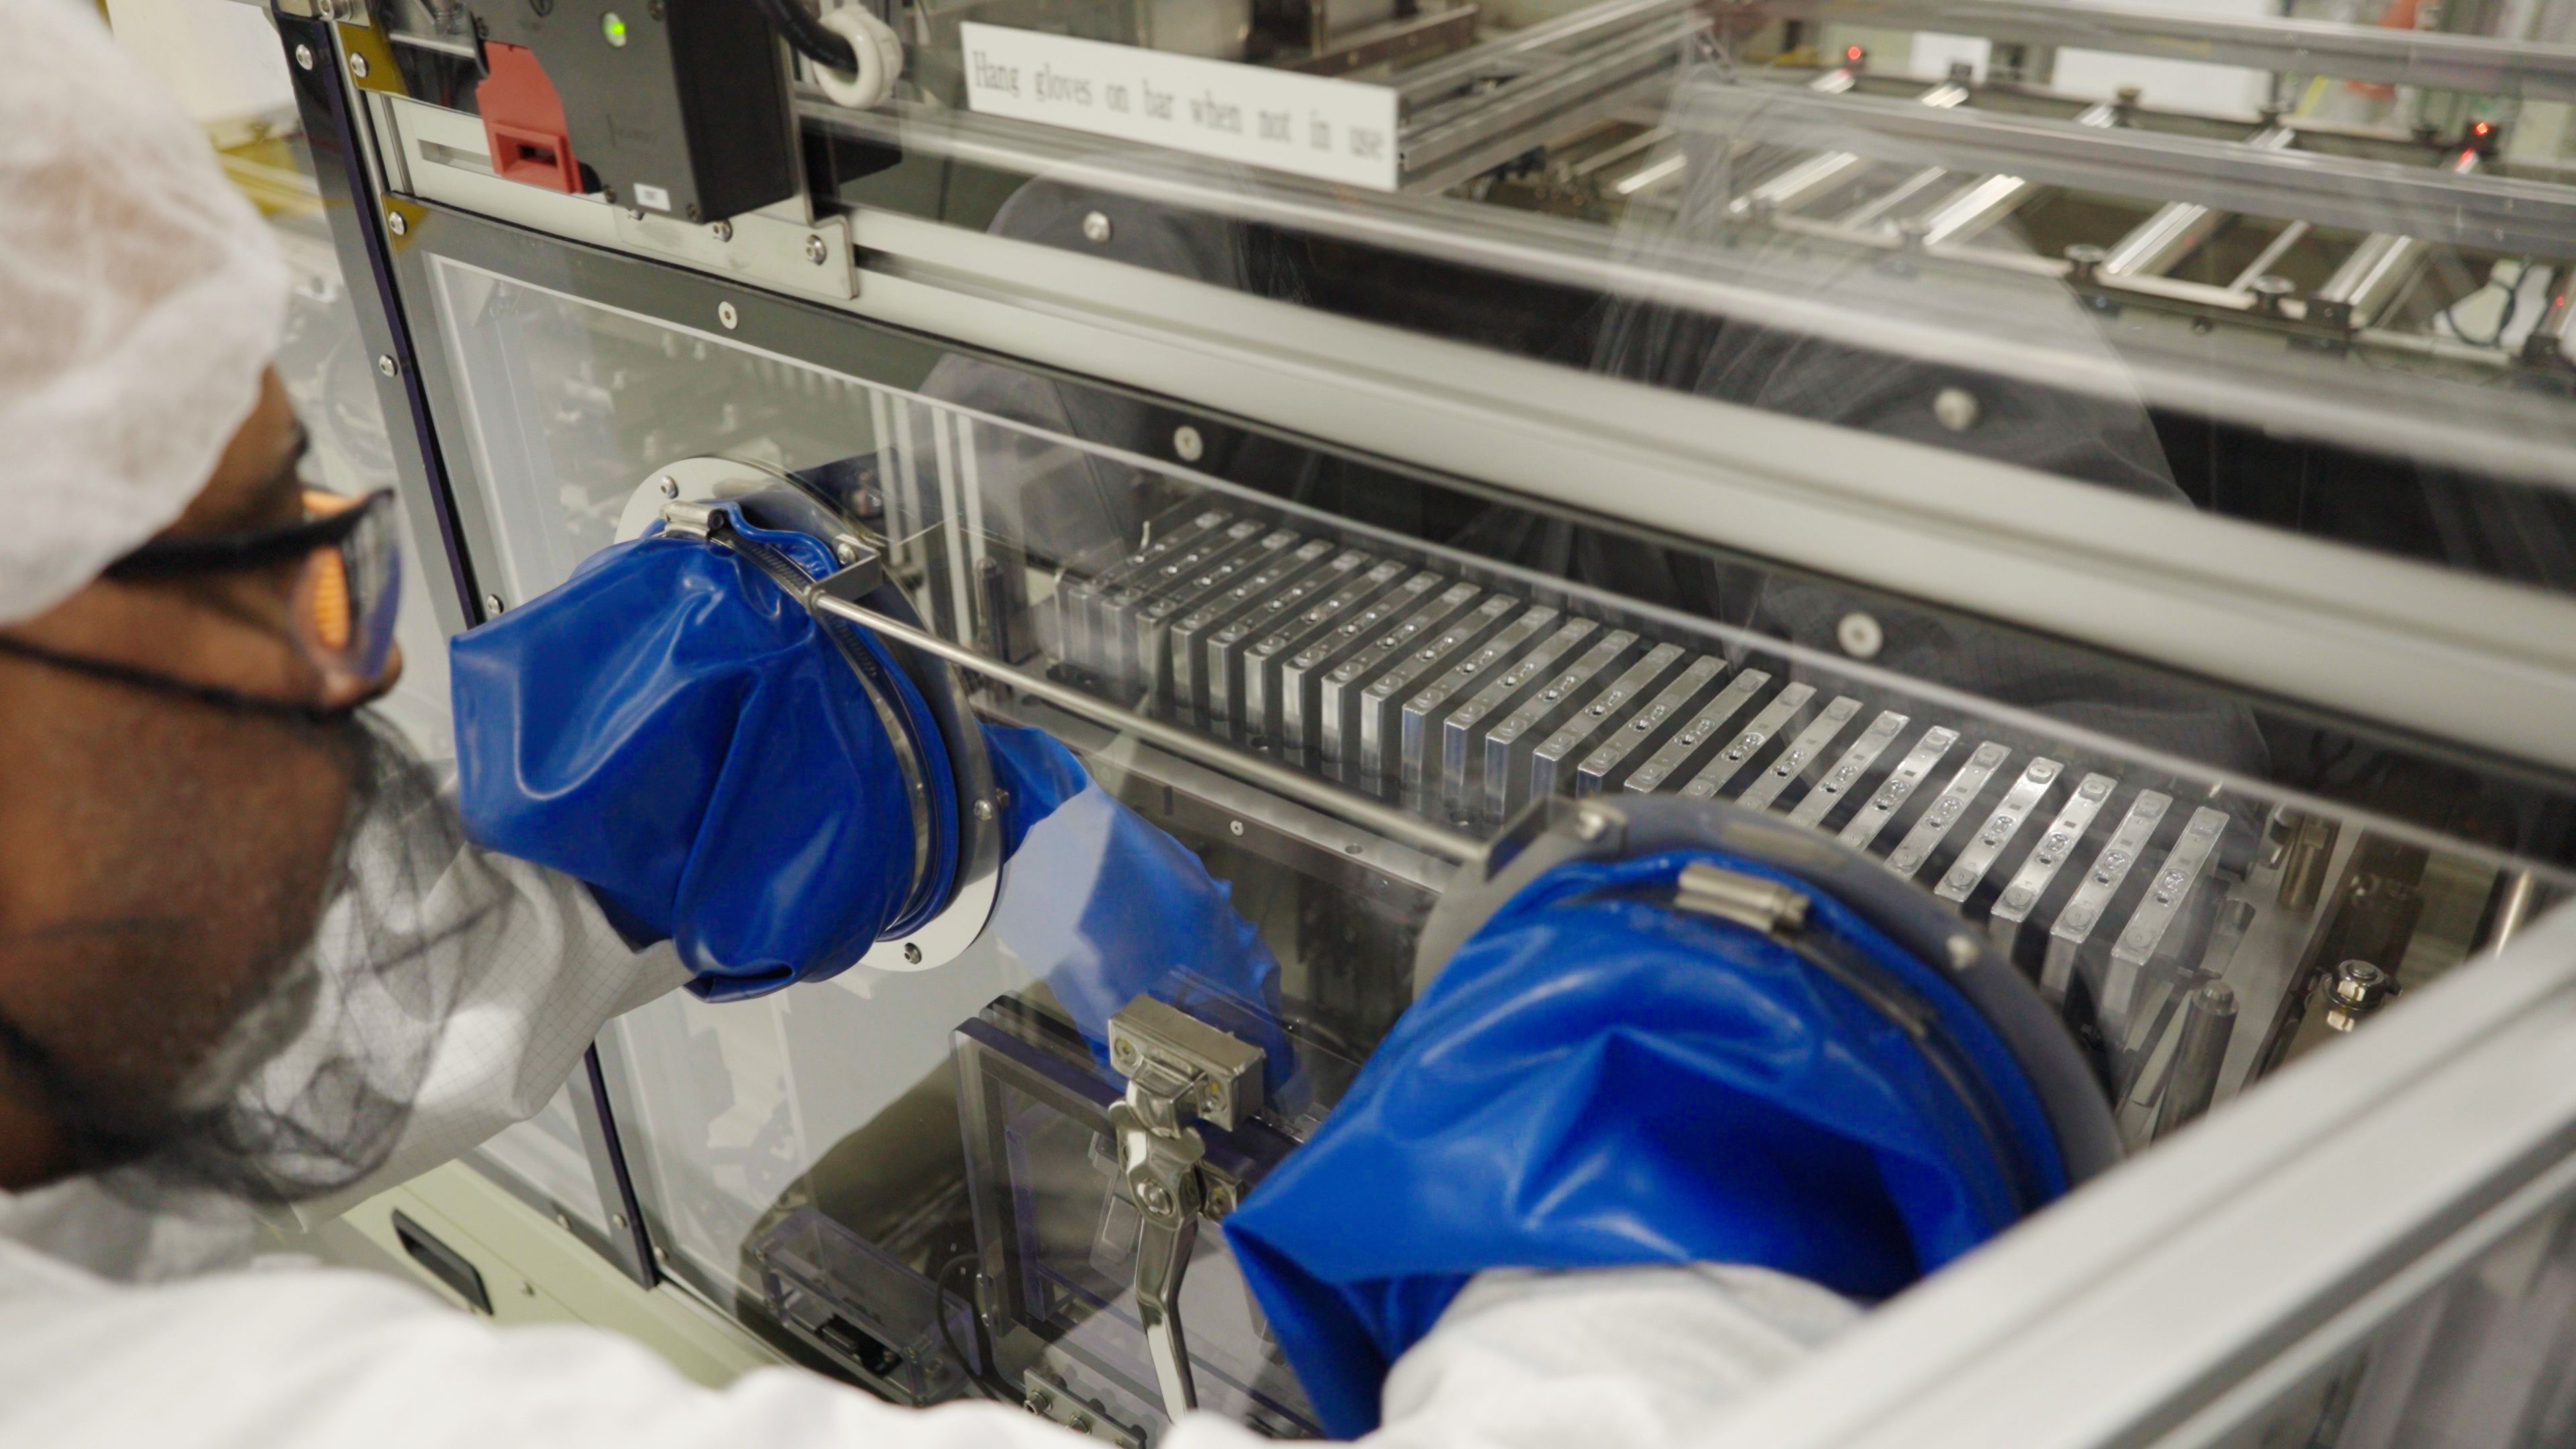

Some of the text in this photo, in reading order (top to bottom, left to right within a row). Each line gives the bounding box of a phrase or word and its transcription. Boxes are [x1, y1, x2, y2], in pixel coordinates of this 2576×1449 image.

[972, 50, 1385, 161] Hang gloves on bar when not in use
